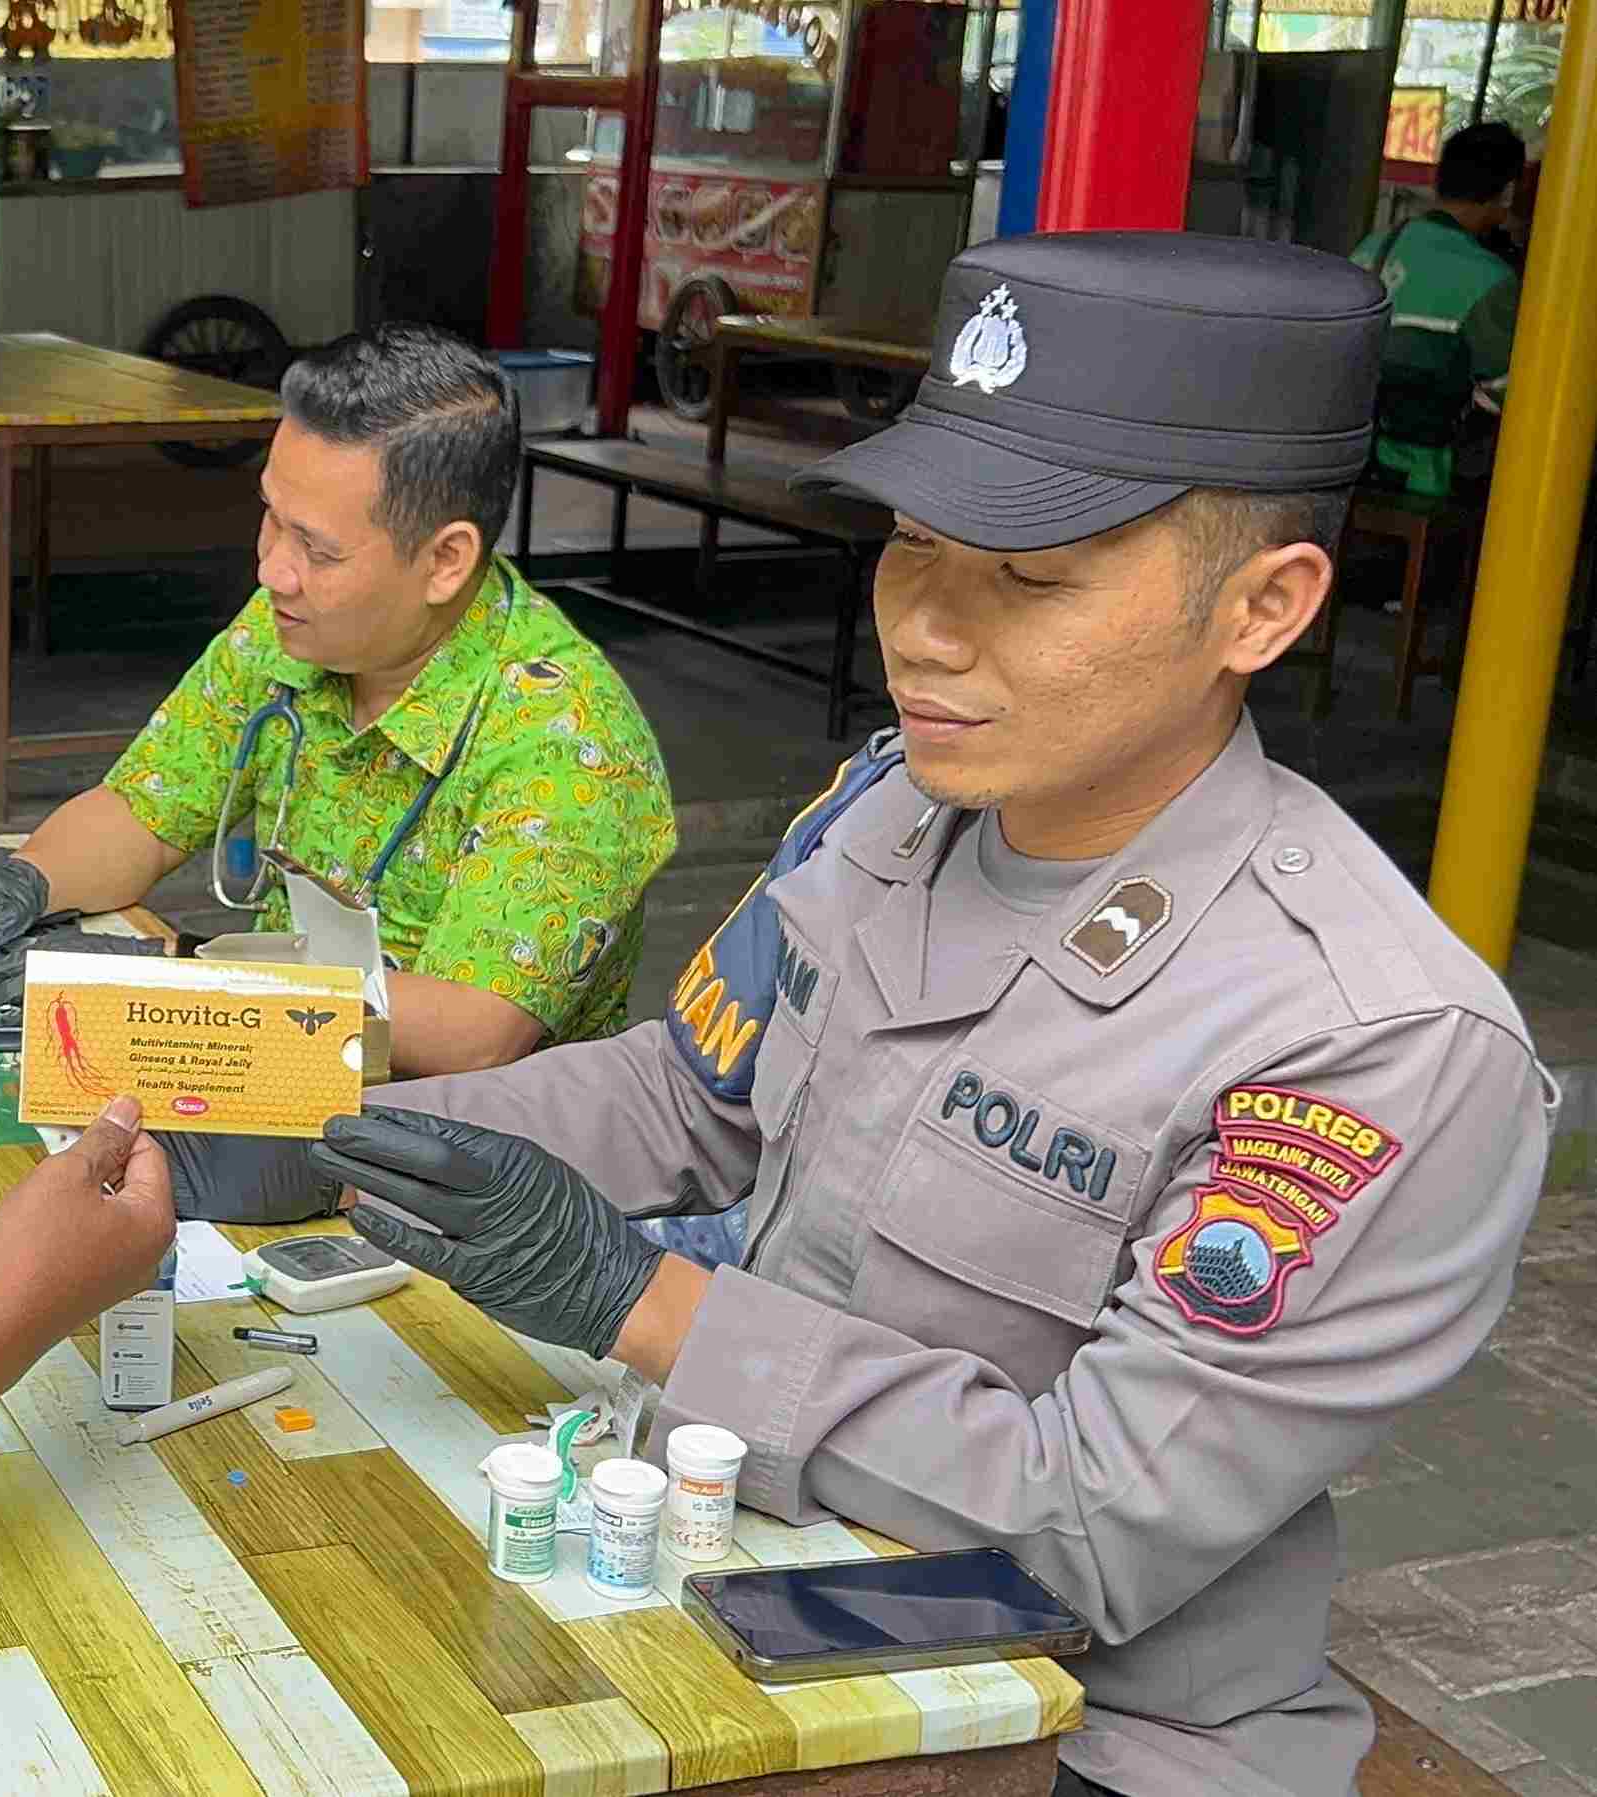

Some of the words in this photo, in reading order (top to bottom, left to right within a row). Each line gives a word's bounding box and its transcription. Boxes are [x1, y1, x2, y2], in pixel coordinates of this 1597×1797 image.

[126, 1001, 261, 1029] Horvita-G
[129, 1053, 175, 1065] Ginseng
[190, 1055, 223, 1067] Royal
[225, 1057, 253, 1069] Jelly
[136, 1079, 174, 1090] Health
[177, 1081, 245, 1094] Supplement
[941, 1069, 1117, 1201] POLRI
[1232, 1138, 1309, 1169] MAGELANG
[1310, 1157, 1353, 1191] KOTA
